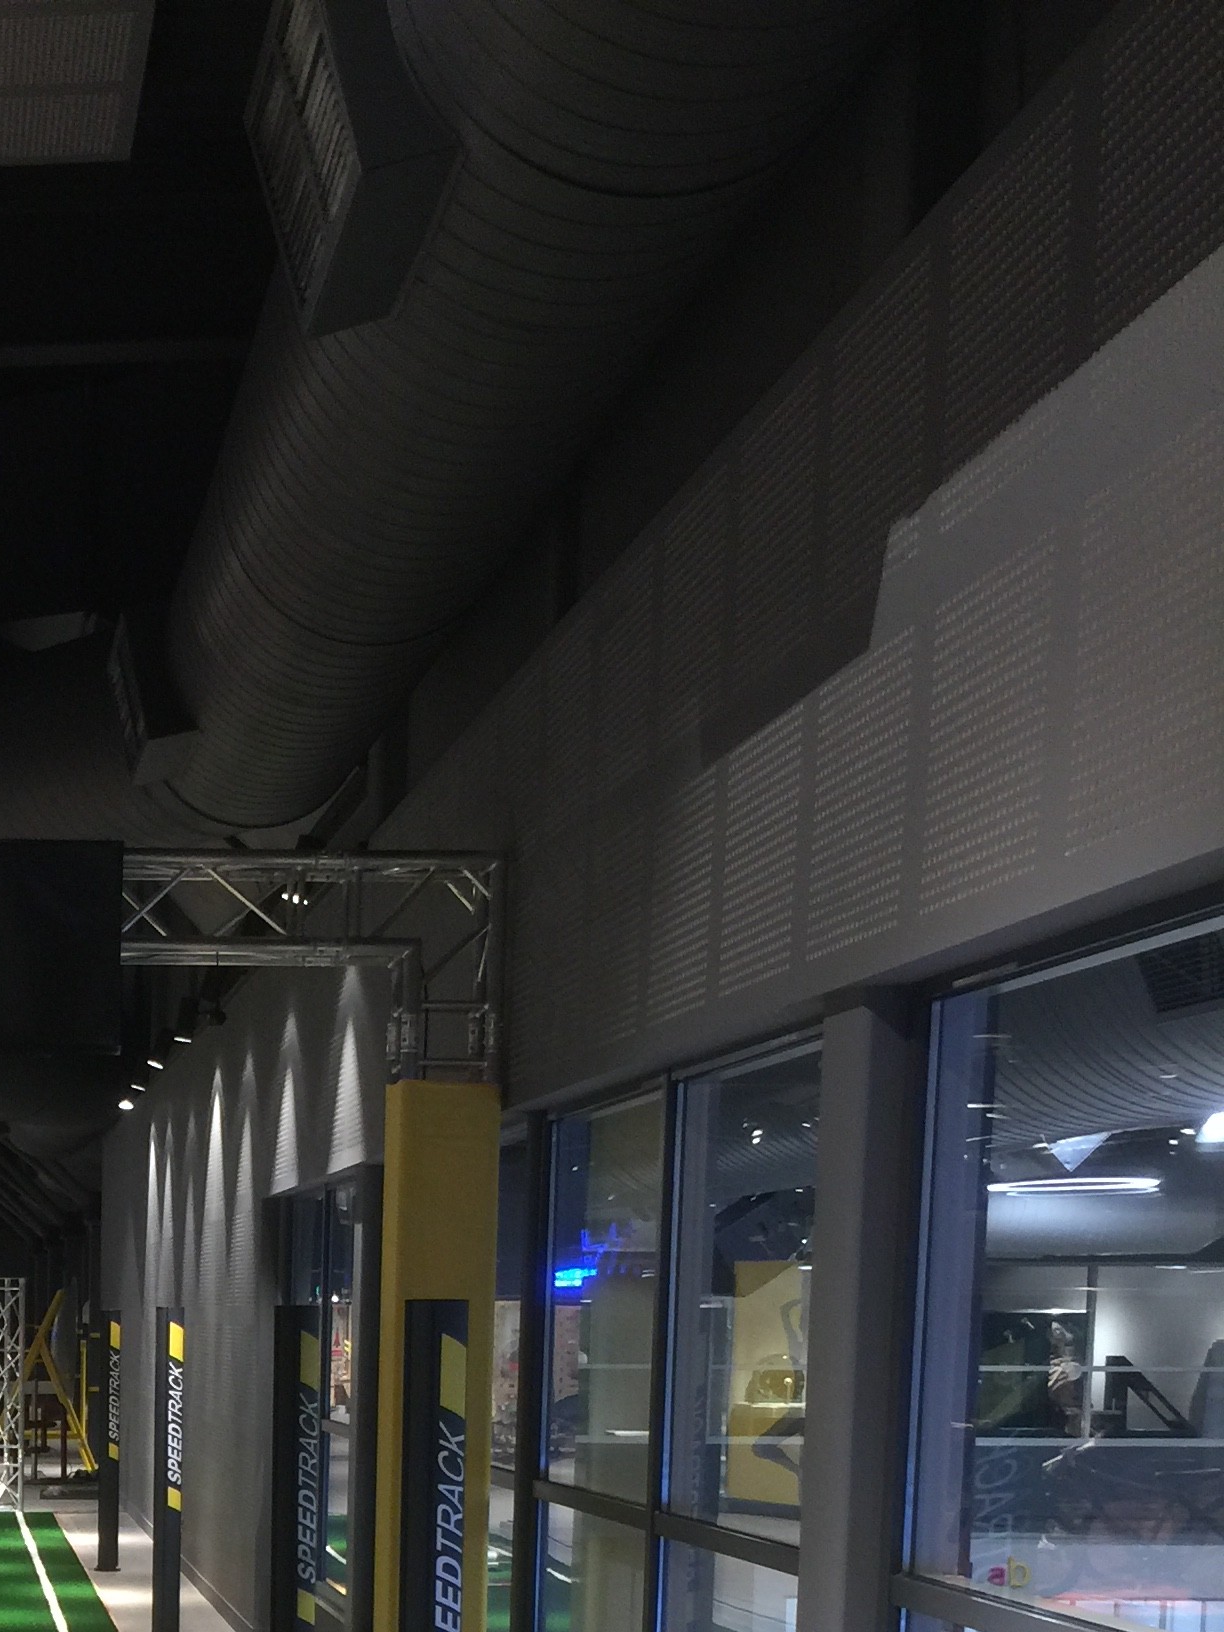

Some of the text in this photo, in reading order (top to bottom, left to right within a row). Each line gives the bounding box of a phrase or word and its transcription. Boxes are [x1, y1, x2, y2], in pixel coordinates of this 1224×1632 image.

[108, 1350, 120, 1442] SPEEDTRACK
[167, 1361, 184, 1485] SPEEDTRACK
[297, 1392, 319, 1584] SPEEDTRACK
